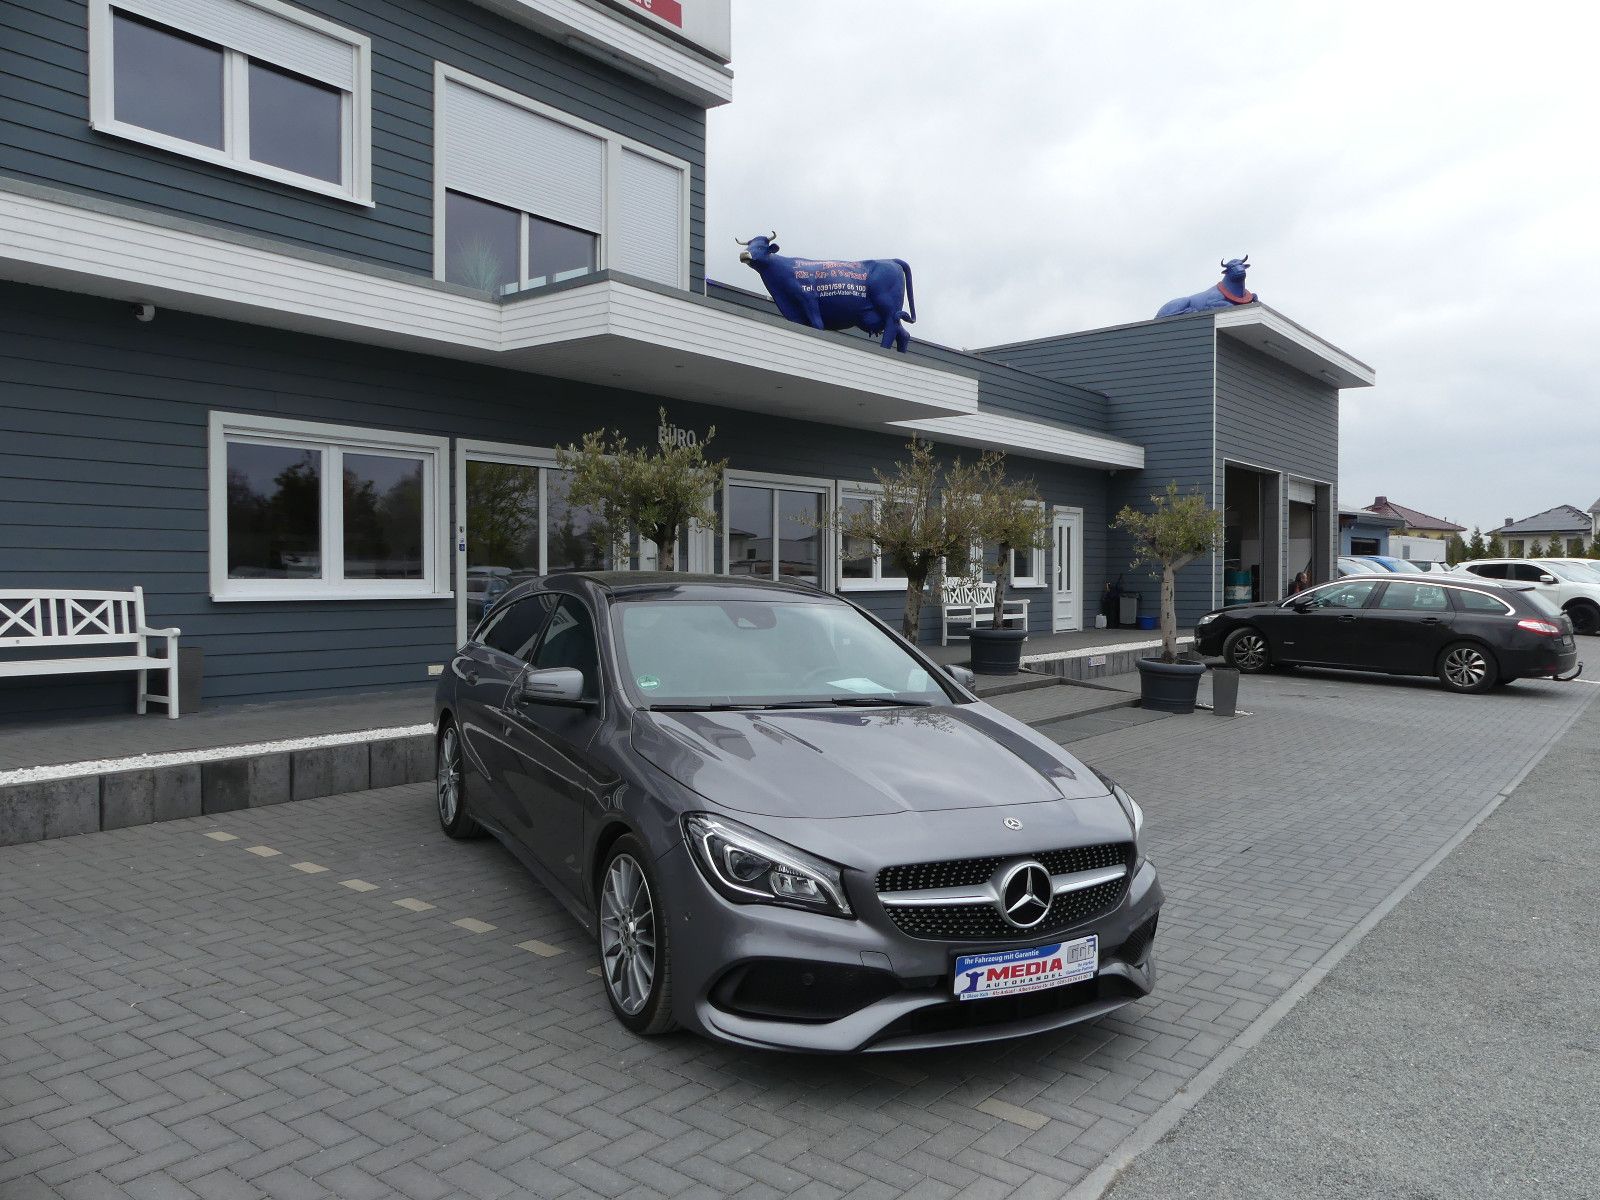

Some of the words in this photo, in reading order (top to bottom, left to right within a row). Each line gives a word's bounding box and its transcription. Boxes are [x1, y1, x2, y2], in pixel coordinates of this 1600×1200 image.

[802, 284, 815, 292] Tel.
[657, 423, 697, 448] BÜRO
[964, 957, 974, 965] Ihr
[974, 954, 1003, 964] Fahrzeug
[1003, 951, 1015, 960] mit
[1014, 949, 1040, 959] Garantie
[986, 957, 1063, 982] MEDIA
[985, 972, 1063, 989] AUTOHANDEL
